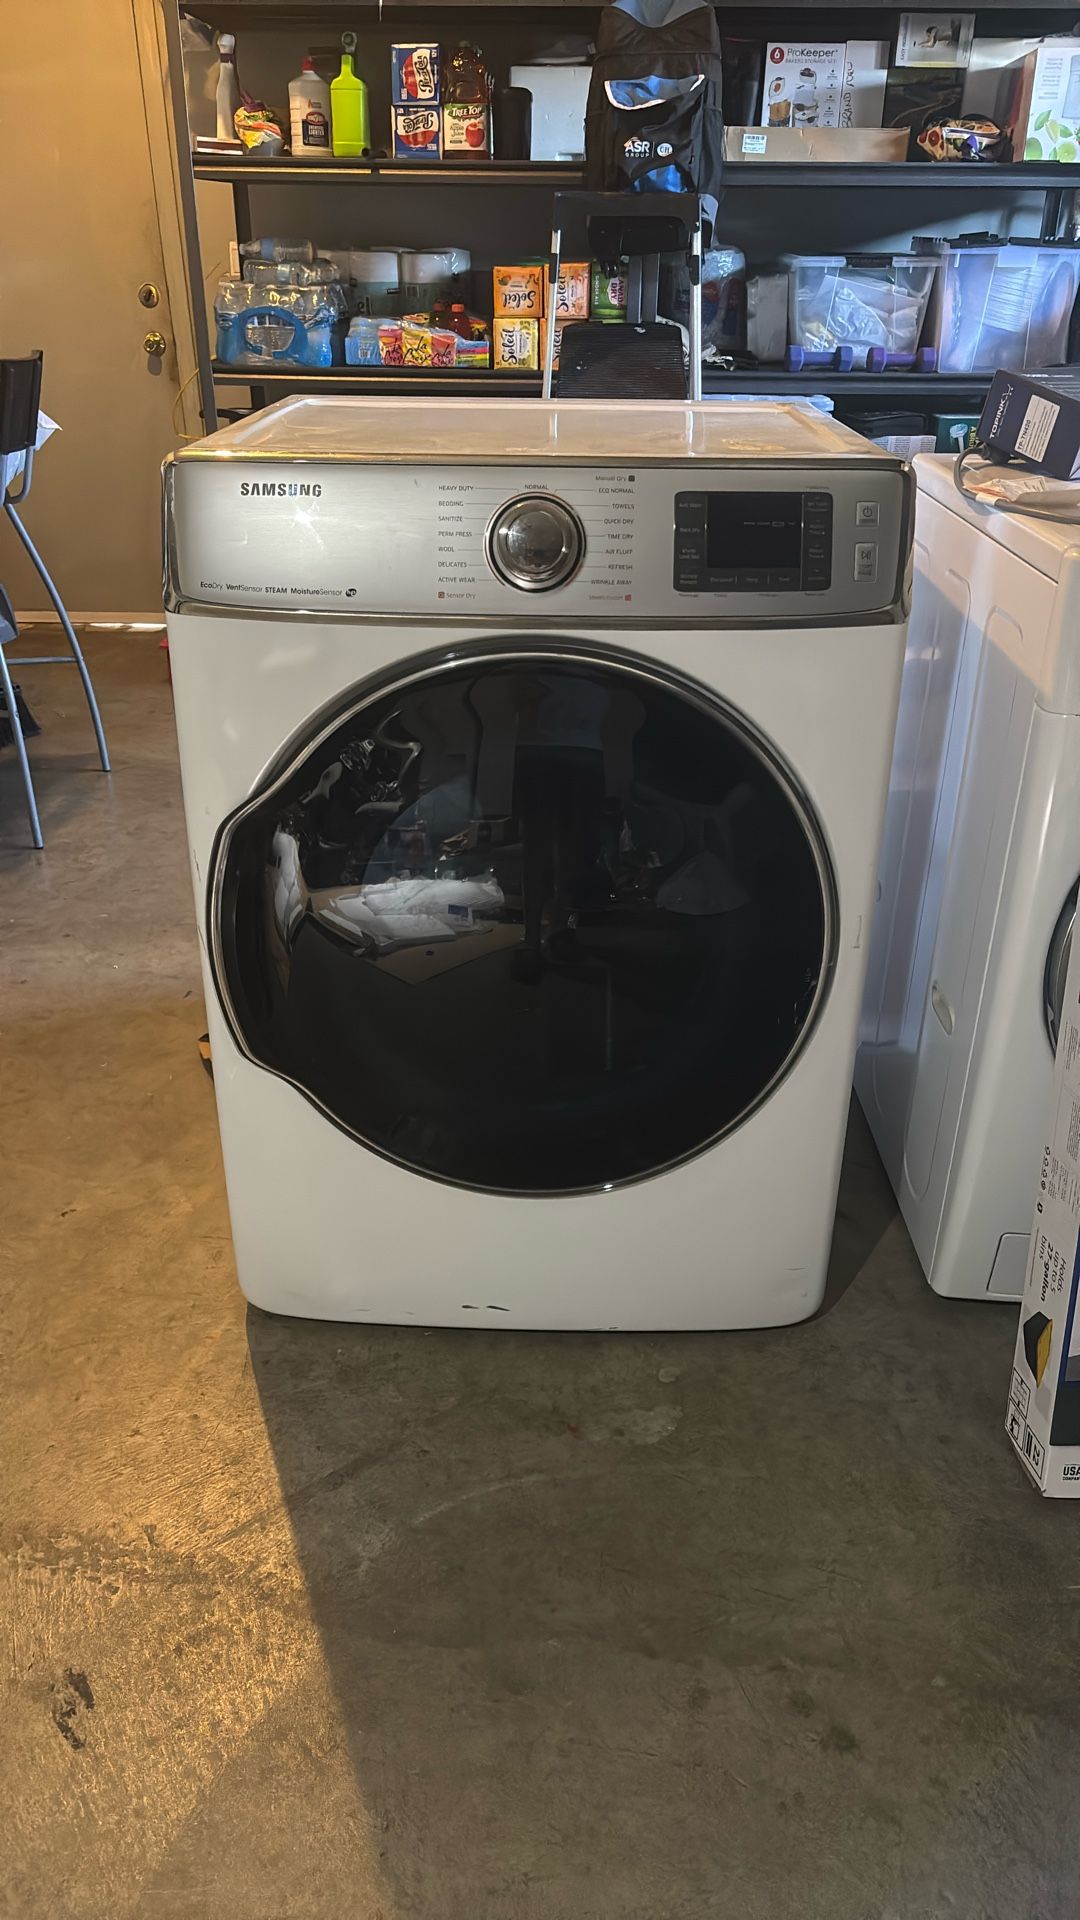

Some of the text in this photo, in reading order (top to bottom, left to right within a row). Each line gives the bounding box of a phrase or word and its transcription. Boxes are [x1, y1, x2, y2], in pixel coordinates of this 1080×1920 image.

[451, 104, 482, 117] TREE TOP
[625, 140, 650, 152] ASR
[503, 290, 536, 309] Soleil
[502, 327, 518, 365] Soleil
[989, 398, 1006, 439] TOPINK
[240, 482, 322, 497] SAMSUNG
[200, 581, 223, 591] EcoDry
[226, 583, 263, 592] VentSensor
[265, 586, 288, 594] STEAM
[291, 587, 343, 596] MoistureSensor
[1039, 1235, 1048, 1261] bins
[1054, 1251, 1060, 1267] up
[1041, 1241, 1054, 1302] 27-gallon
[1051, 1268, 1058, 1282] to
[1057, 1257, 1067, 1294] Holds
